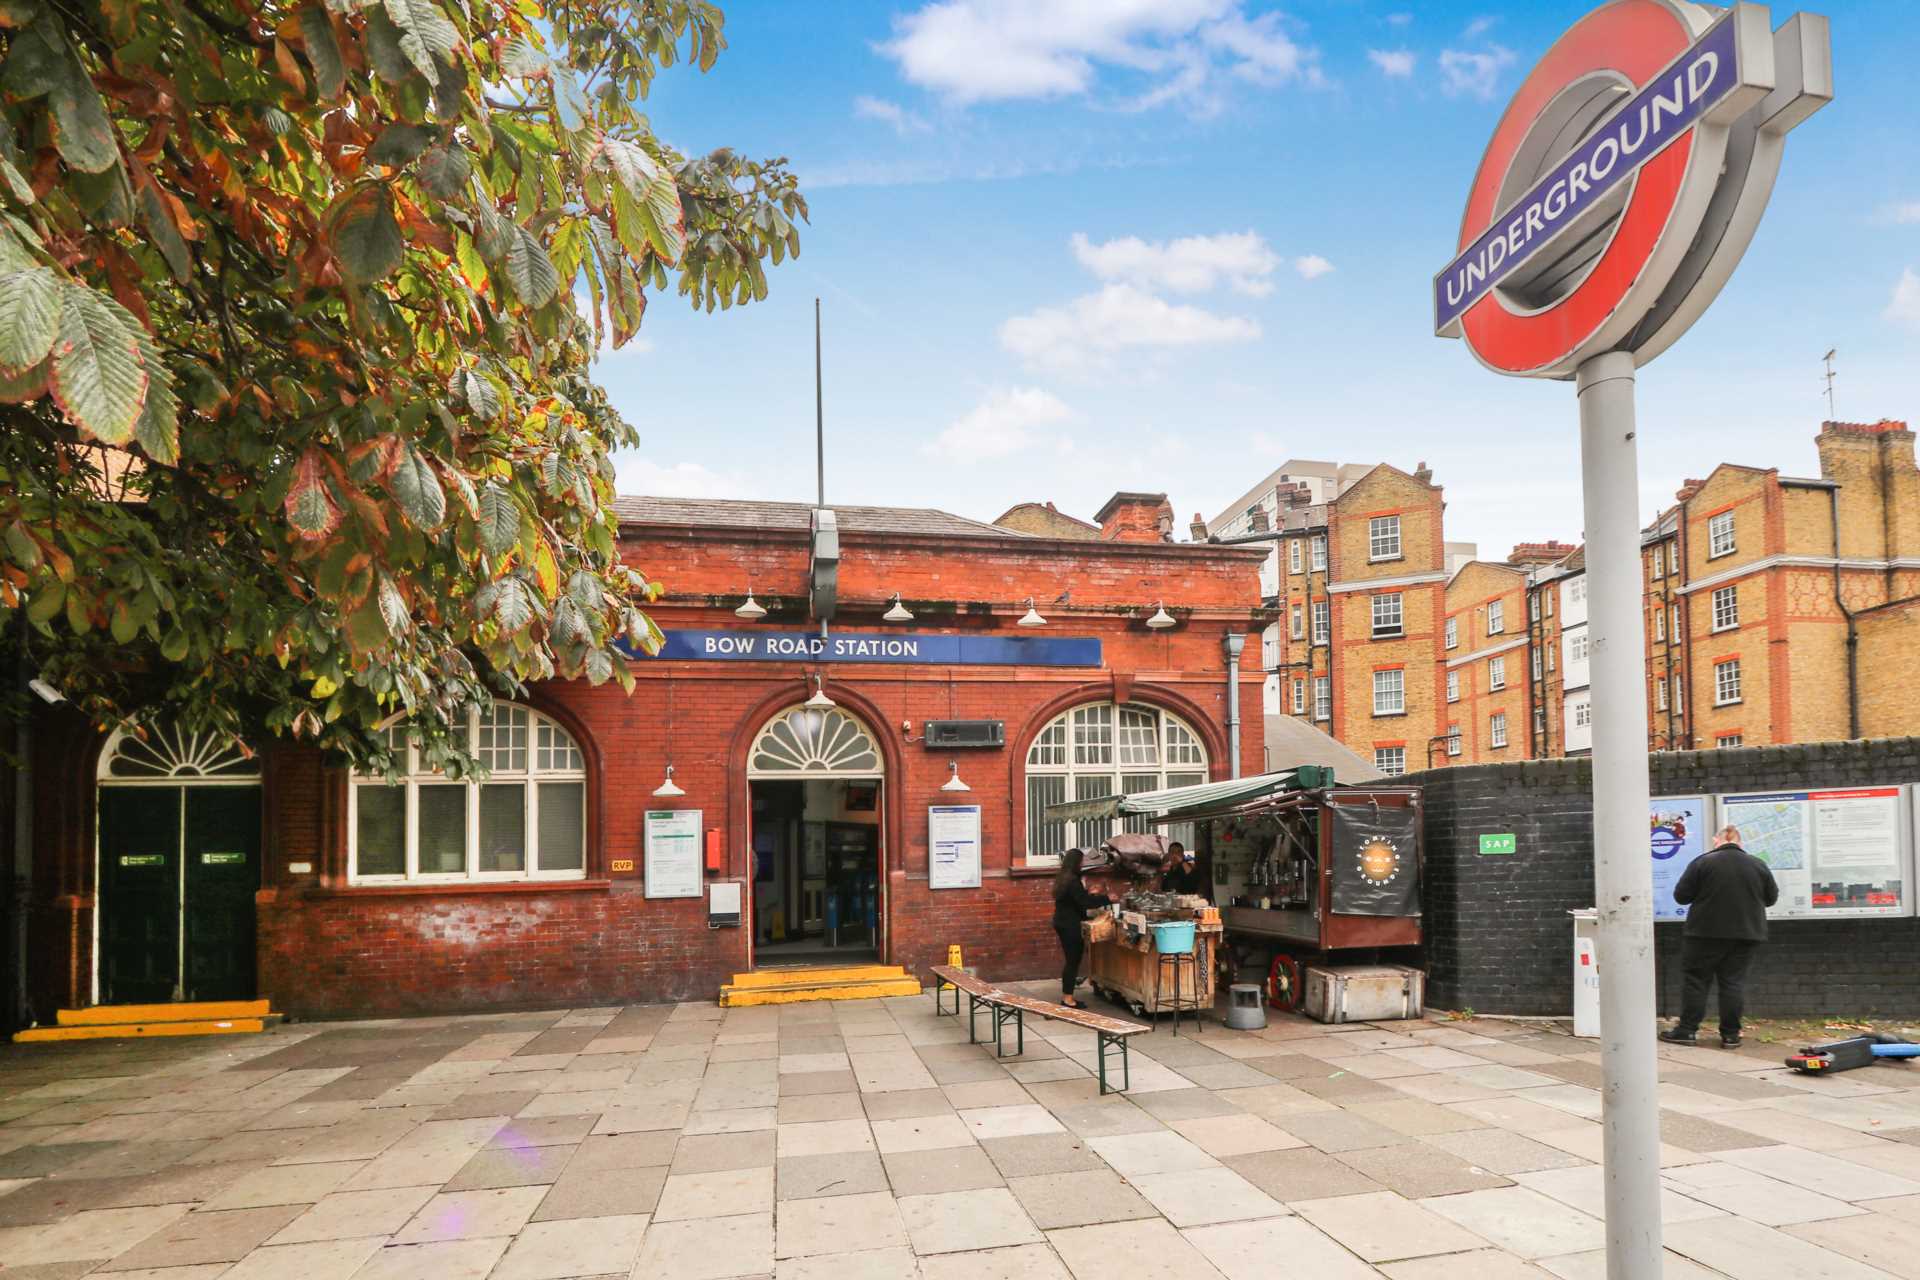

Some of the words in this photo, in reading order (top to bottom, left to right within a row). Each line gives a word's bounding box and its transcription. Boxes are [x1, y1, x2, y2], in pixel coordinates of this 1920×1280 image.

[1446, 51, 1719, 306] UNDERGROUND
[705, 637, 754, 654] BOW
[766, 638, 824, 655] ROAD
[834, 639, 918, 657] STATION
[1486, 839, 1510, 849] SAP
[613, 861, 632, 870] RVP
